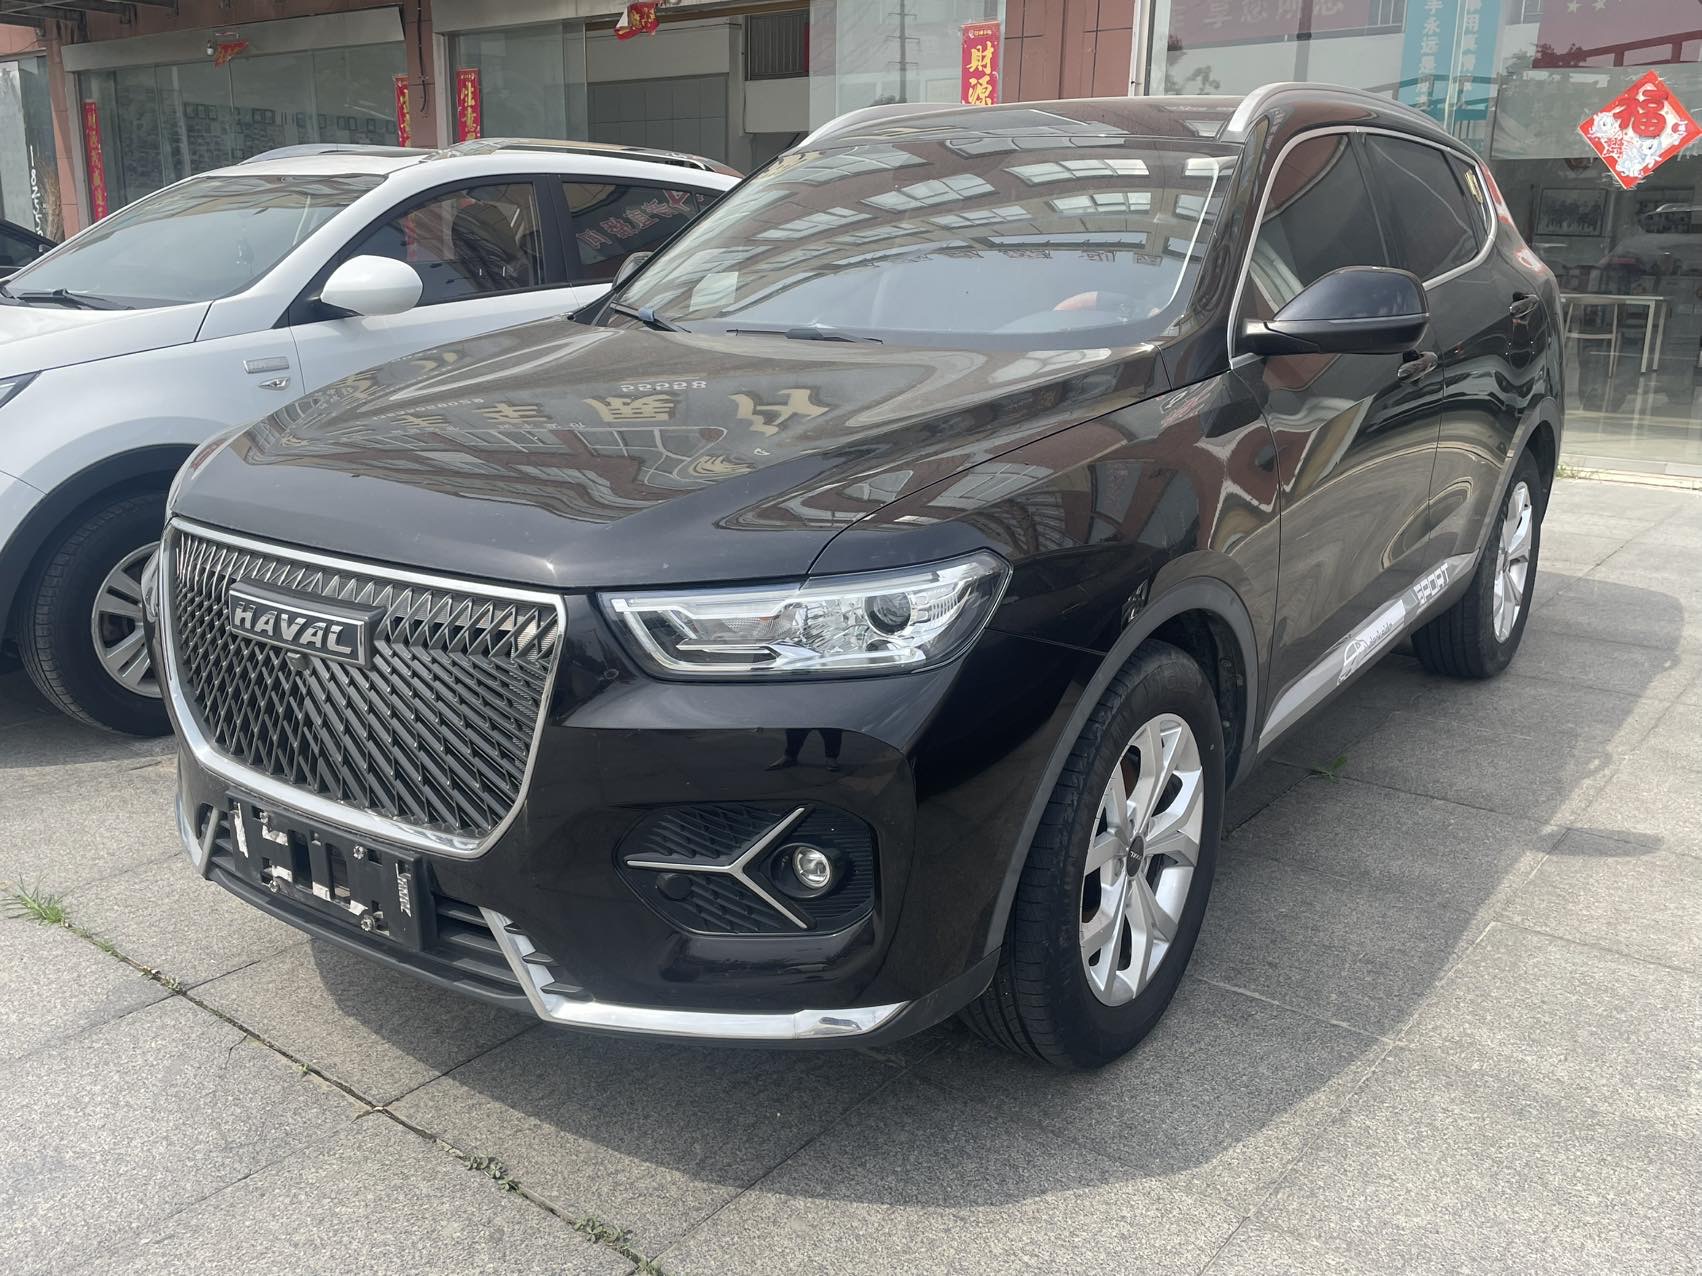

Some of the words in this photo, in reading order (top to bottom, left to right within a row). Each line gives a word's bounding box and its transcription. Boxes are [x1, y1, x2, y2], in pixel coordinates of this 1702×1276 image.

[966, 41, 994, 105] 财源
[1613, 89, 1669, 139] 福
[1413, 562, 1449, 606] SPORT
[234, 601, 352, 654] HAVAL
